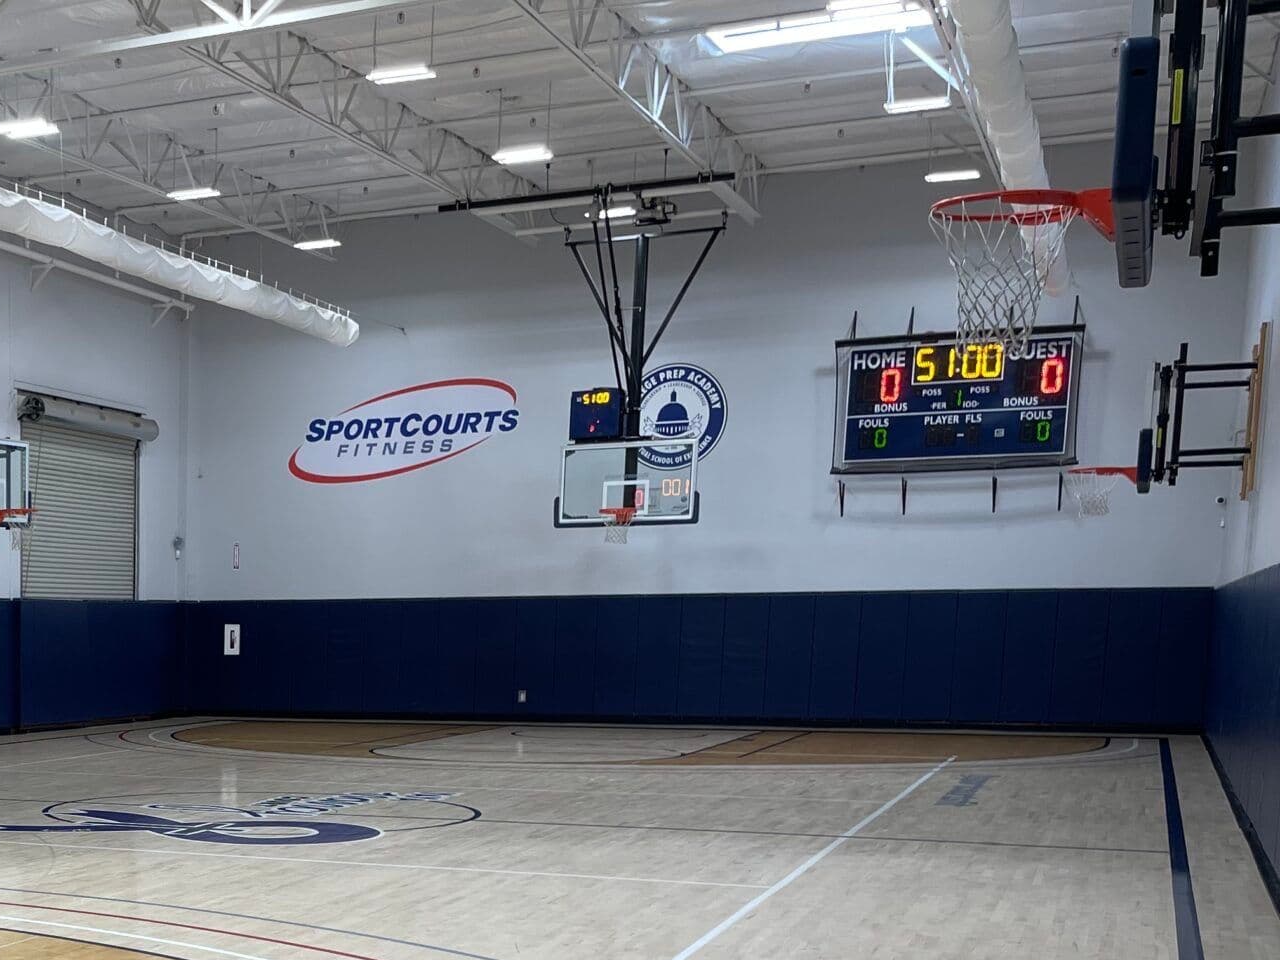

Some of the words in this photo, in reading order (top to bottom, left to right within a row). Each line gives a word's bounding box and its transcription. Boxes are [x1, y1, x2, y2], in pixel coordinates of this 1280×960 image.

[854, 351, 906, 370] HOME
[1041, 359, 1064, 394] 0
[659, 369, 685, 381] PREP
[687, 371, 721, 409] ACADEMY
[880, 369, 901, 402] 0
[970, 386, 990, 394] POSS
[922, 388, 942, 396] POSS
[1003, 396, 1039, 407] BONUS
[875, 403, 908, 413] BONUS
[924, 415, 959, 425] PLAYER
[965, 414, 982, 424] FLS
[1020, 410, 1053, 420] FOULS
[306, 409, 519, 442] SPORTCOURTS
[859, 418, 889, 428] FOULS
[337, 439, 453, 458] FITNESS
